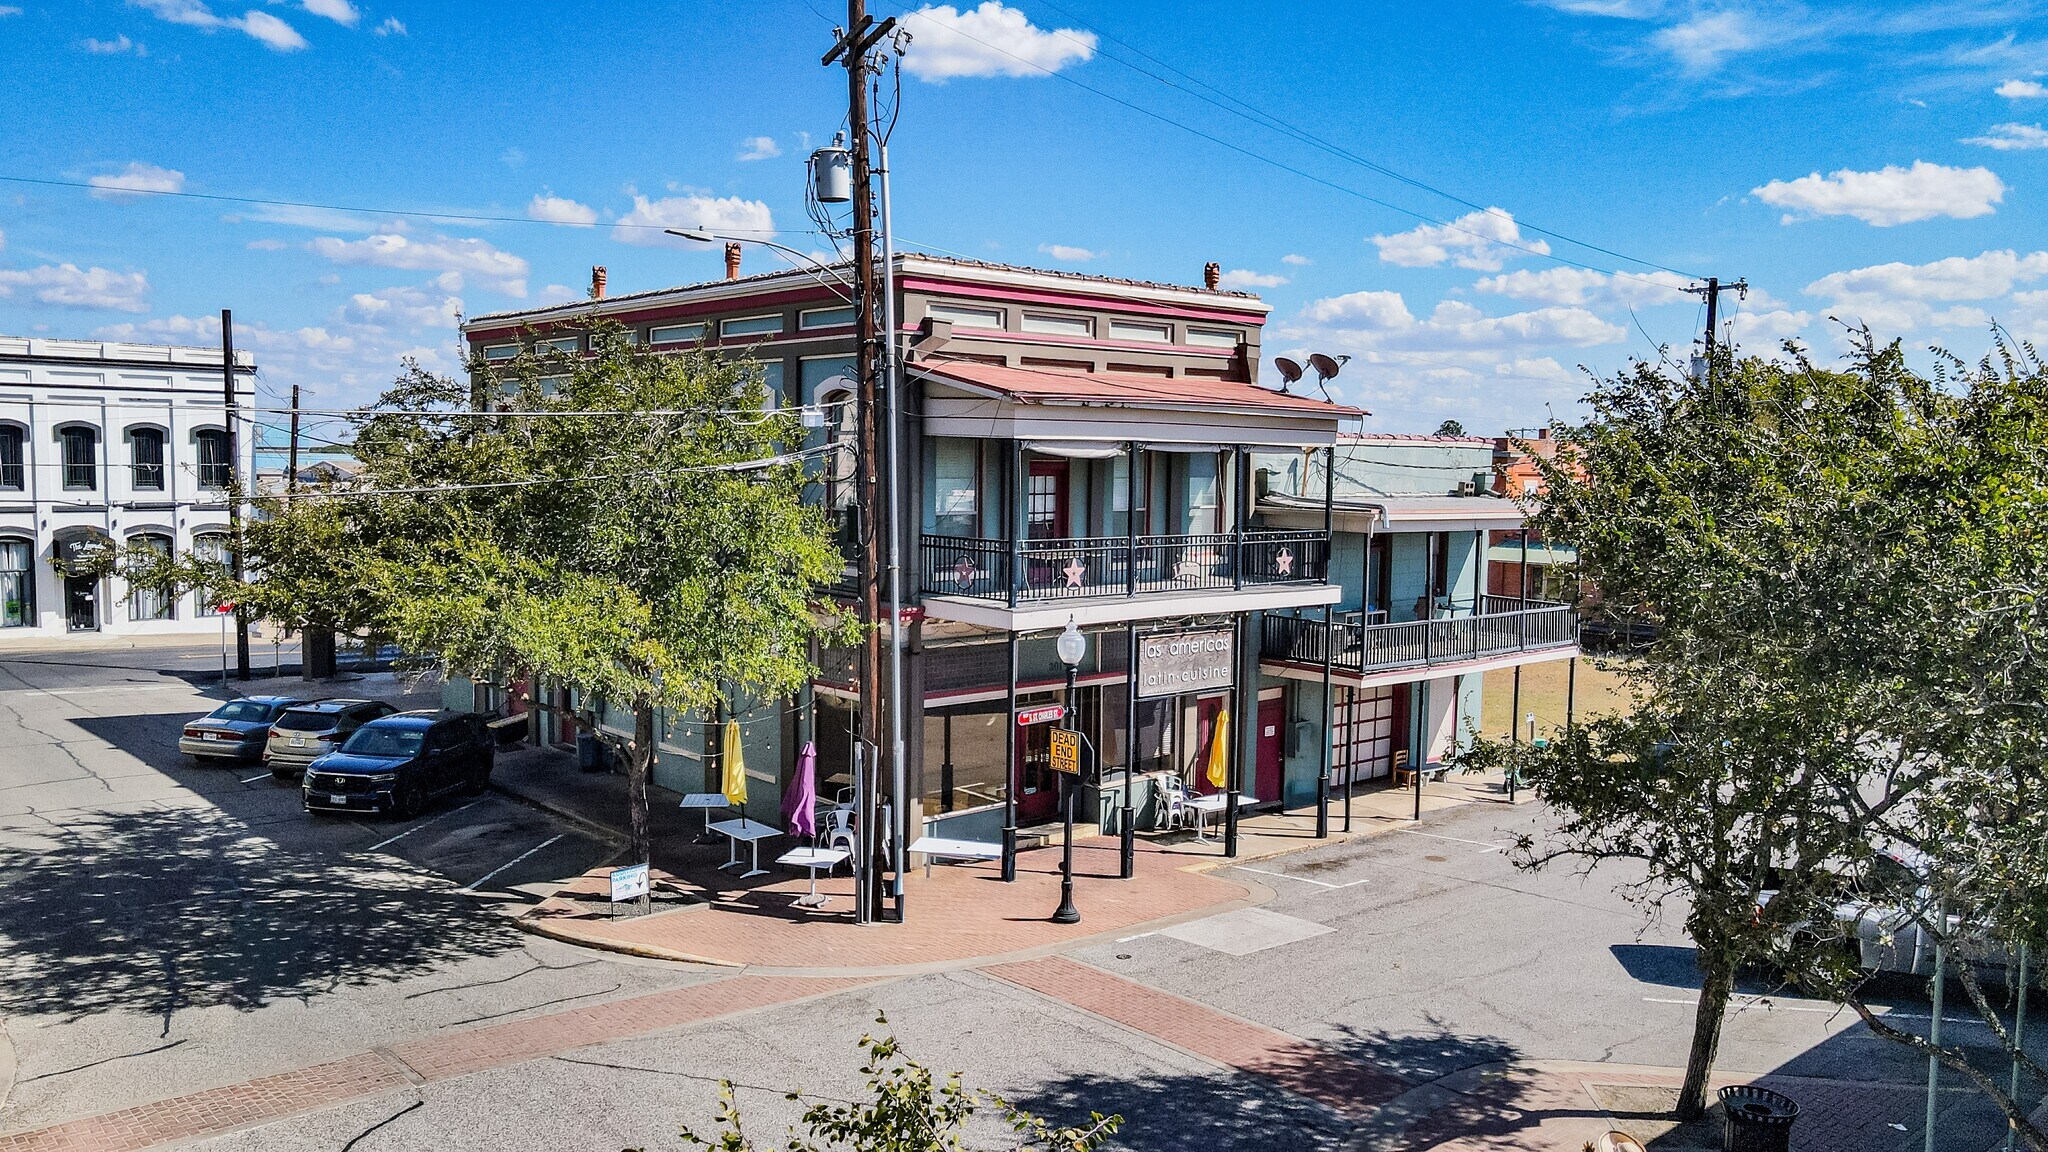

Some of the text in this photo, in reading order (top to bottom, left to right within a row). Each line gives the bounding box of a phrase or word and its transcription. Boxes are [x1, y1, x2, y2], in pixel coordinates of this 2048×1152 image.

[1143, 637, 1229, 658] las americas
[1052, 731, 1076, 746] DEAD
[1055, 744, 1073, 758] END
[1051, 756, 1076, 772] STREET
[612, 873, 638, 882] PARKING
